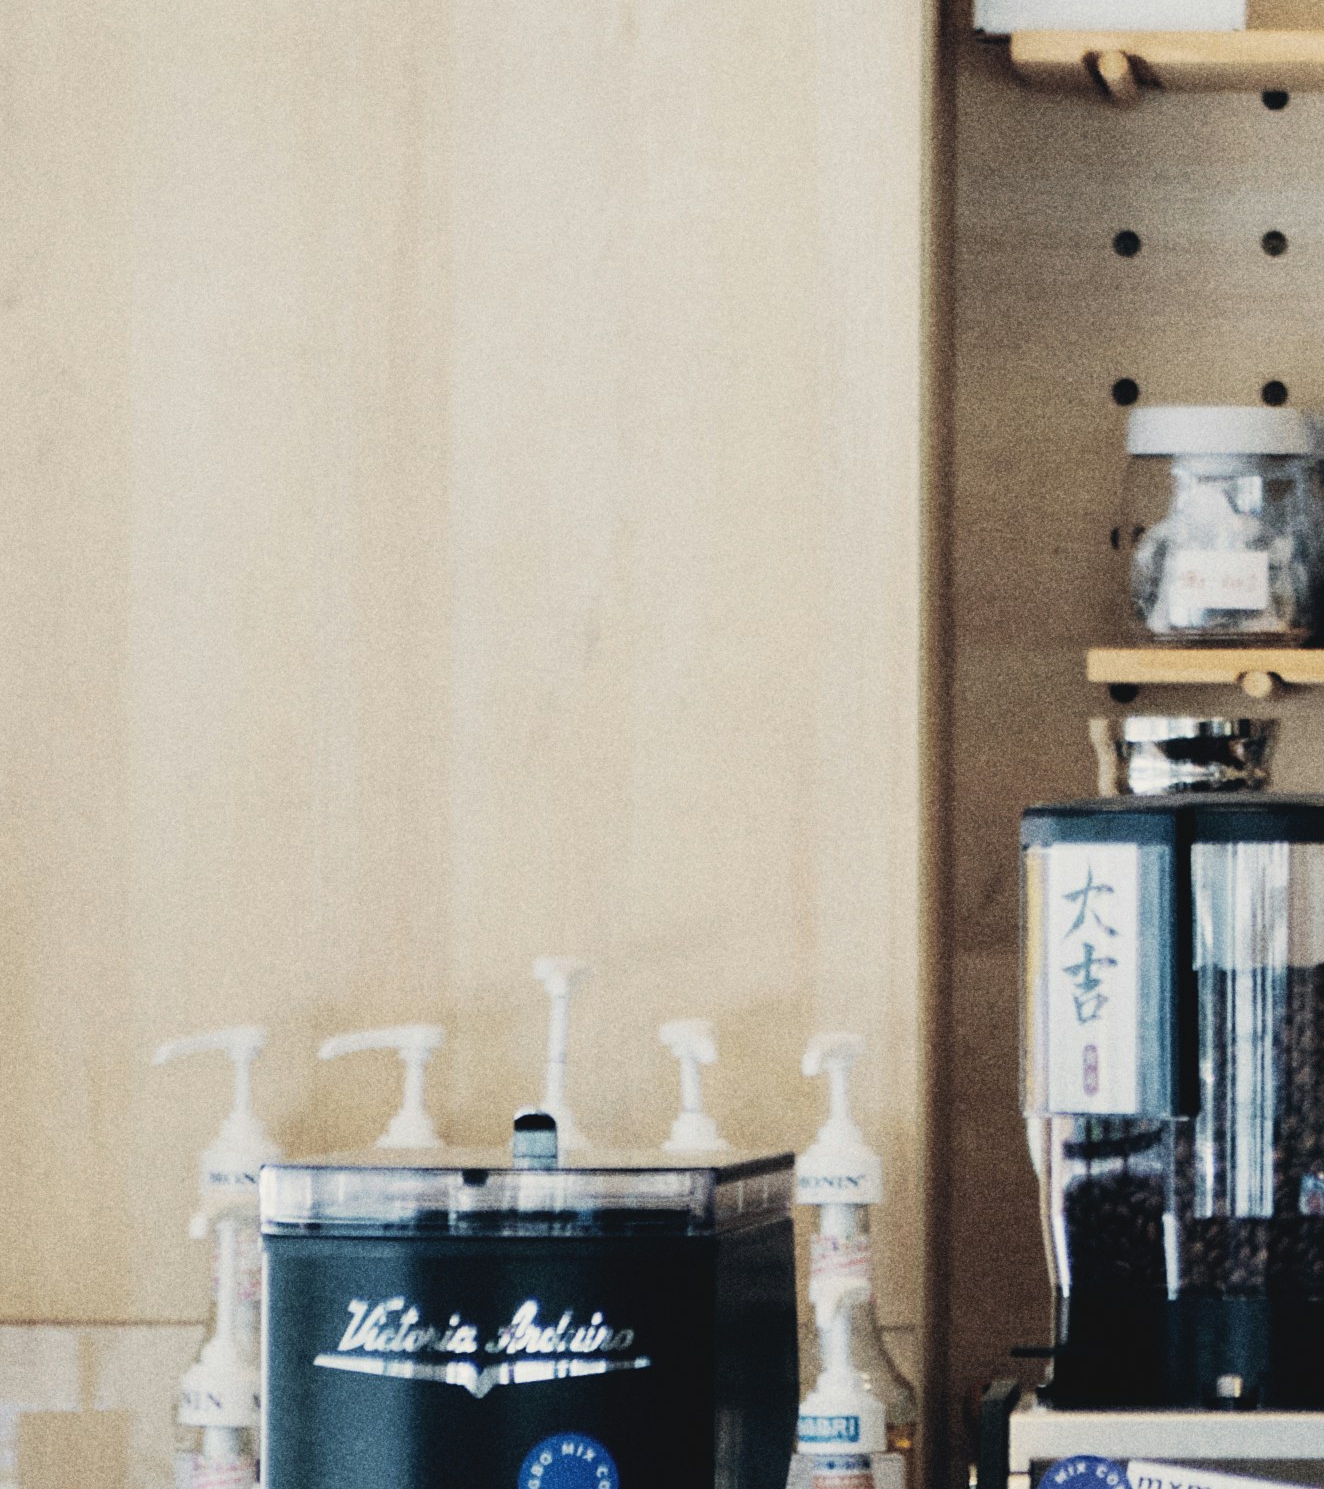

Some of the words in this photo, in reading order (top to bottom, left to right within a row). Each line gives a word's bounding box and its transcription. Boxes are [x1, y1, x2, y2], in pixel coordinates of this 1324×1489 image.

[1060, 860, 1119, 1025] 大吉
[338, 1295, 478, 1353] Victoria
[485, 1298, 635, 1355] Arduino
[561, 1441, 597, 1463] MIX
[1054, 1461, 1087, 1485] MIX
